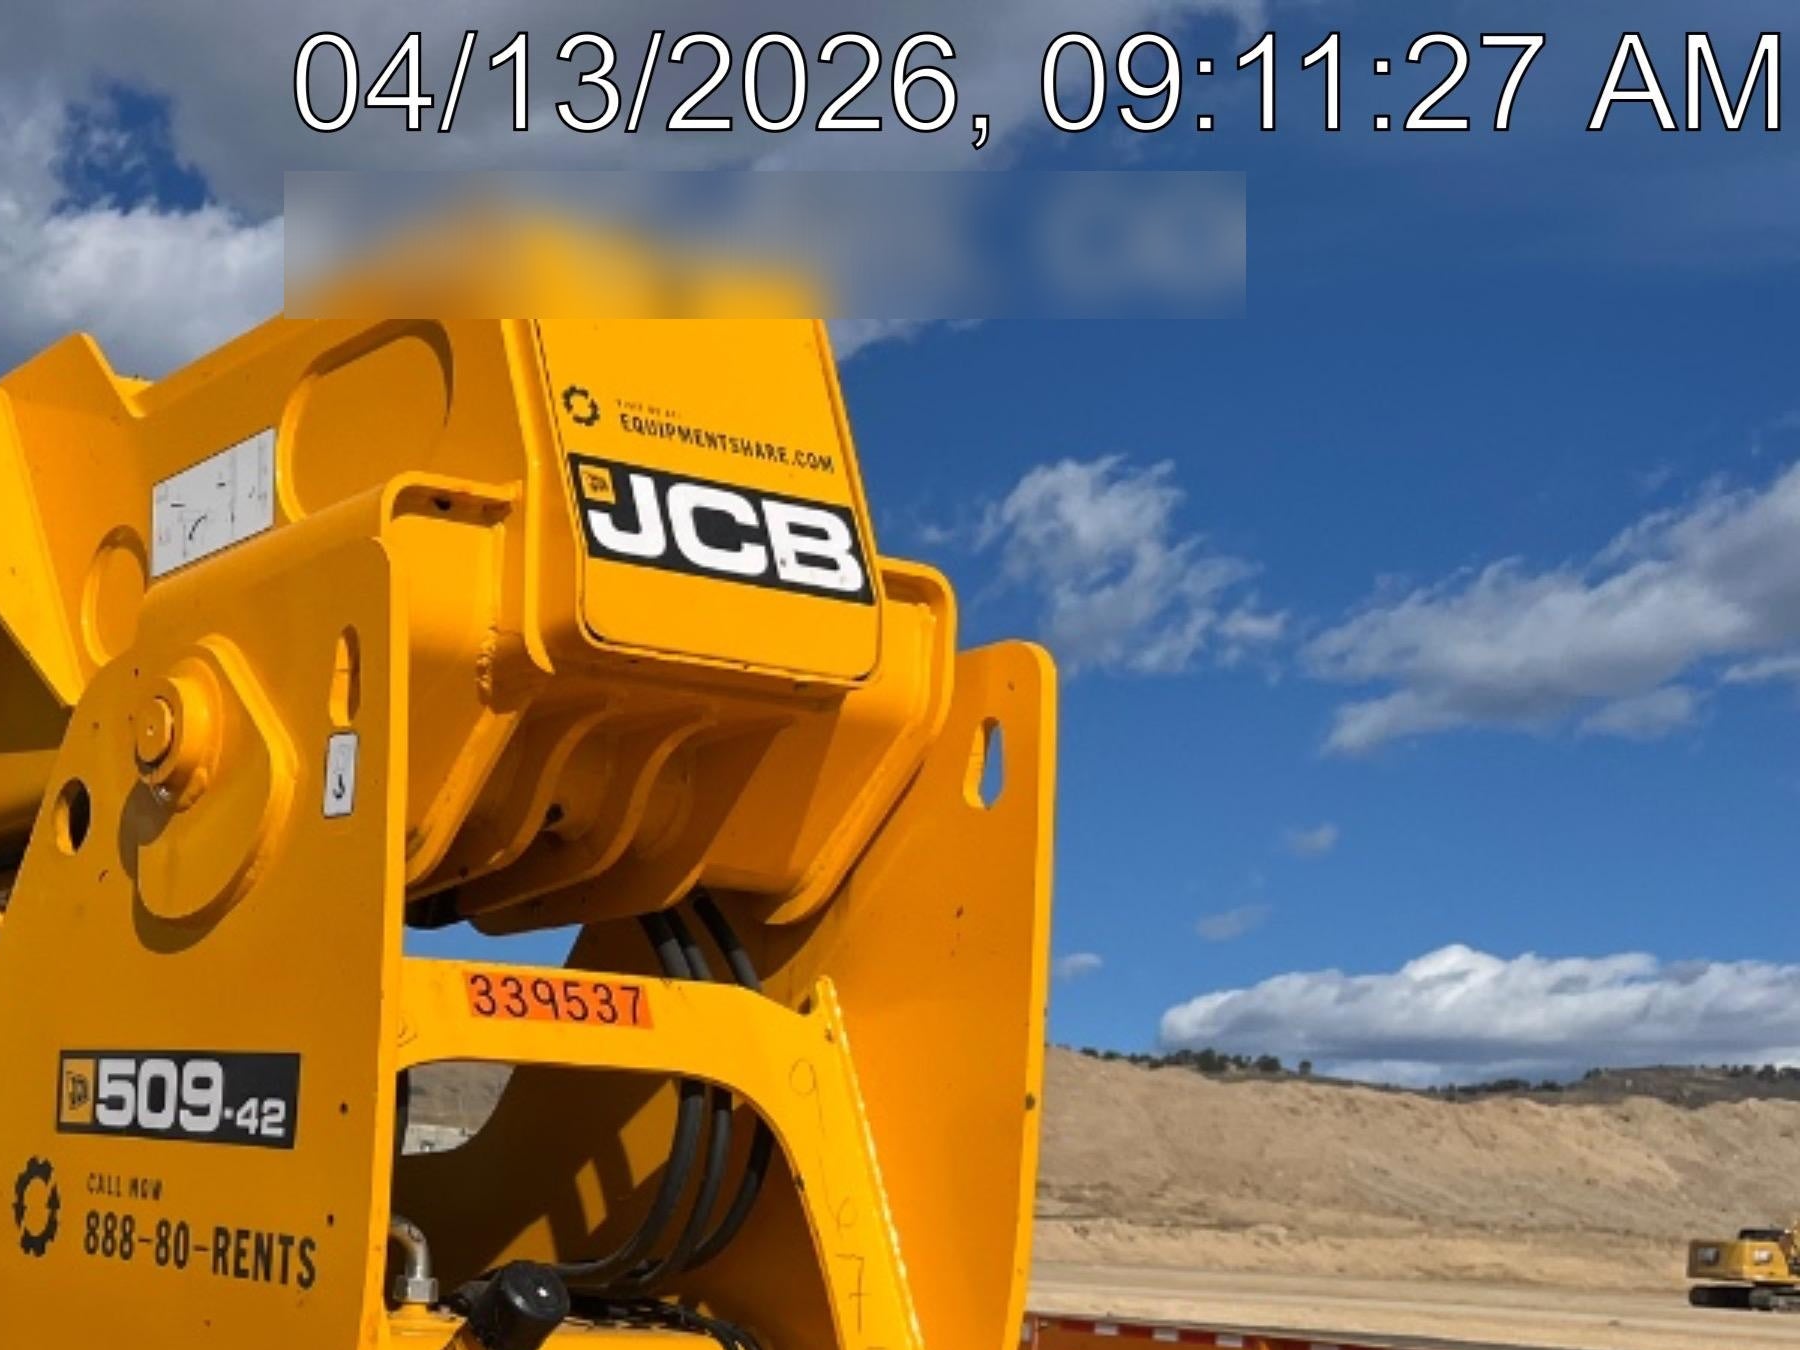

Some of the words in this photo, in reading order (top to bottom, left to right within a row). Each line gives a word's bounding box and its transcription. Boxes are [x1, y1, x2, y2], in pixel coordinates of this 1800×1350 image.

[619, 413, 835, 474] EQUIPMENTSHARE.COM
[587, 472, 865, 593] JCB
[469, 973, 640, 1026] 339537
[86, 1171, 122, 1199] CALL
[83, 1209, 317, 1291] 888-80-RENTS
